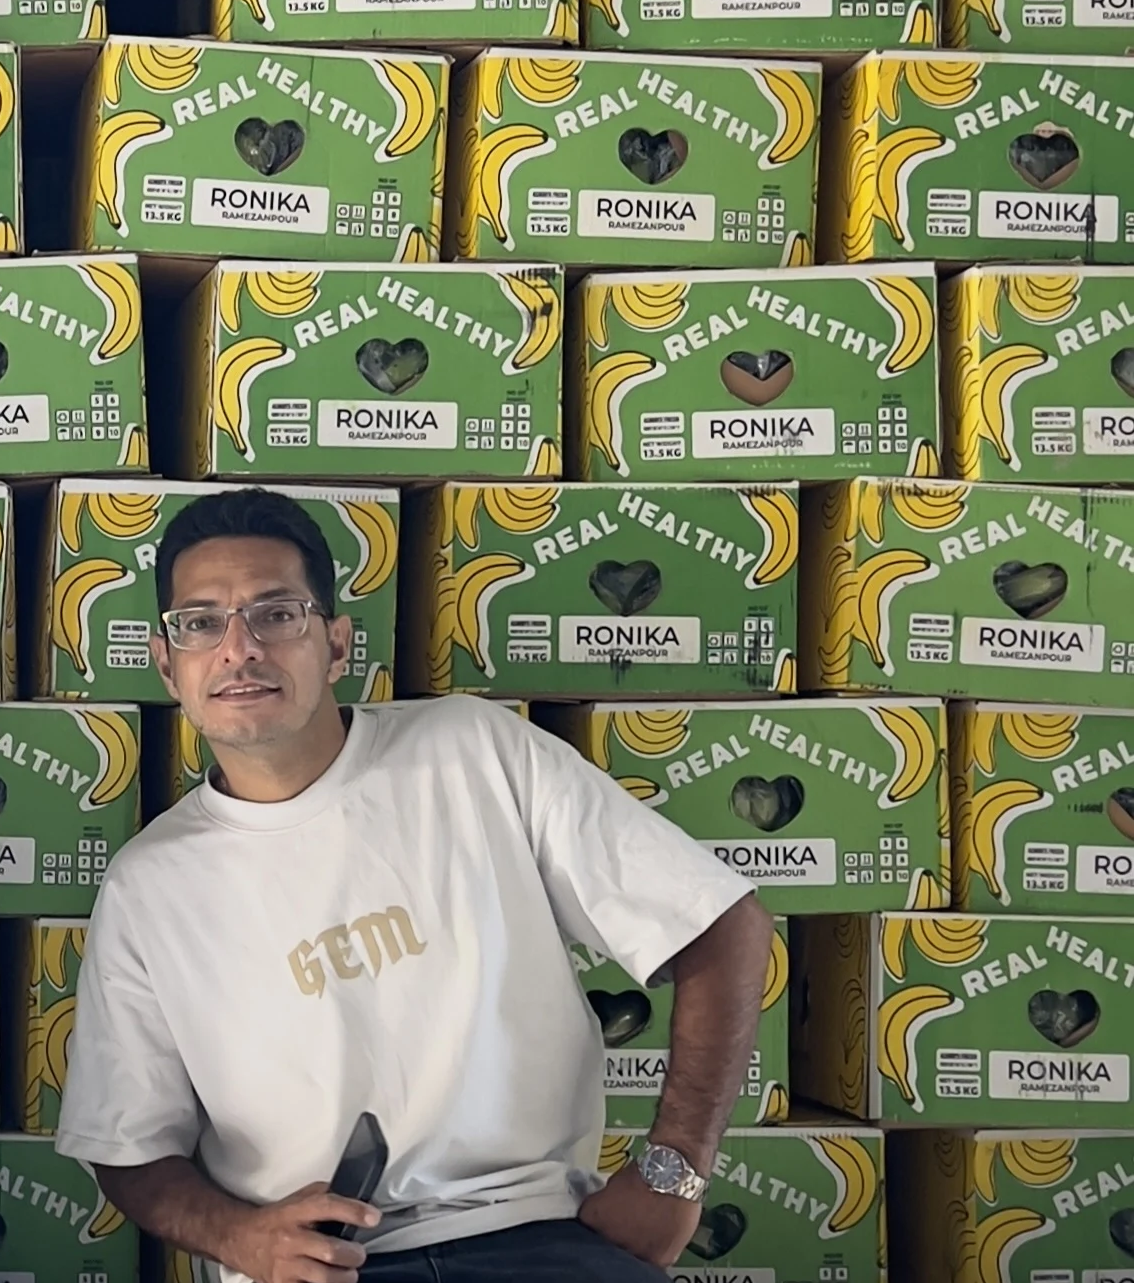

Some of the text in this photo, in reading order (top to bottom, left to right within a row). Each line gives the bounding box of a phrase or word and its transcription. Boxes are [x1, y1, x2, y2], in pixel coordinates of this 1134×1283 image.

[721, 0, 801, 13] RAMEZANPOUR
[172, 57, 387, 146] REAL HEALTHY
[554, 68, 770, 153] REAL HEALTHY
[953, 88, 1039, 139] REAL
[210, 187, 310, 214] RONIKA
[596, 197, 697, 222] RONIKA
[995, 199, 1098, 224] RONIKA
[608, 220, 686, 233] RAMEZANPOUR
[949, 224, 966, 236] KG
[293, 276, 514, 359] REAL HEALTHY
[662, 285, 888, 363] REAL HEALTHY
[336, 408, 438, 431] RONIKA
[710, 415, 815, 441] RONIKA
[348, 431, 427, 441] RAMEZANPOUR
[533, 491, 756, 574] REAL HEALTHY
[938, 513, 1027, 564] REAL
[576, 624, 680, 647] RONIKA
[978, 625, 1084, 653] RONIKA
[130, 655, 147, 667] KG
[665, 714, 888, 793] REAL HEALTHY
[1047, 878, 1065, 890] KG
[961, 945, 1047, 997] REAL
[1007, 1058, 1112, 1083] RONIKA
